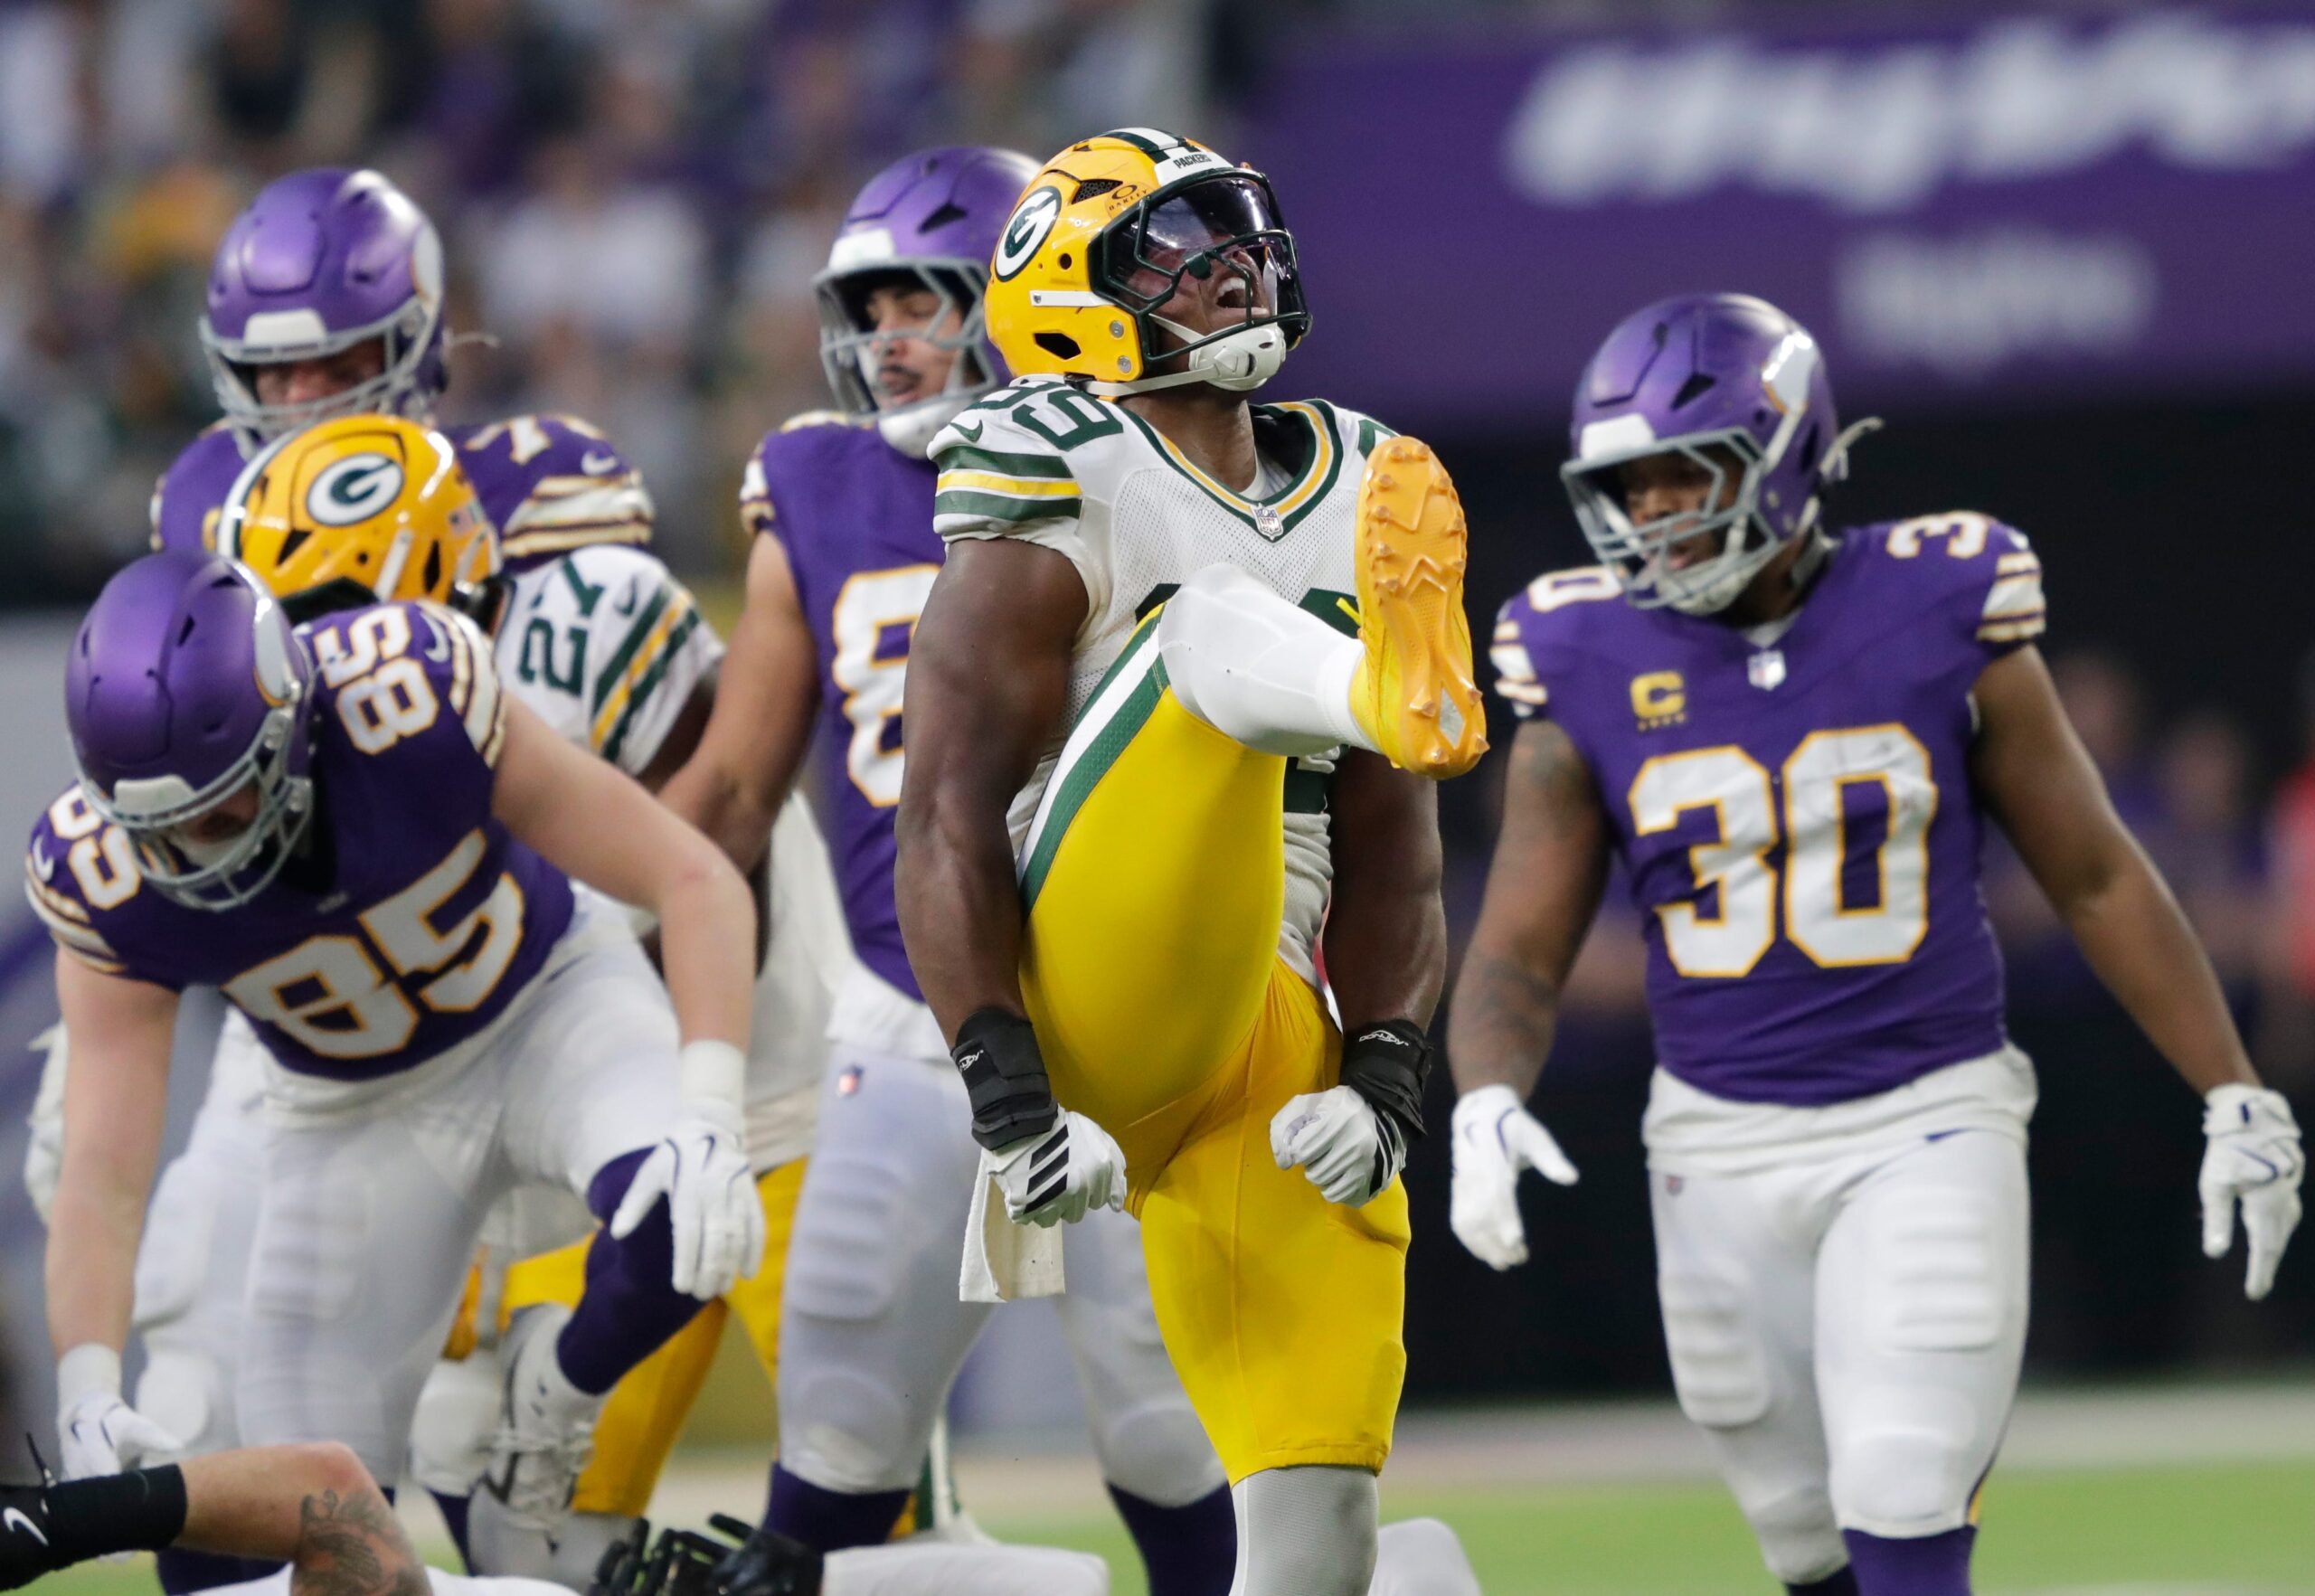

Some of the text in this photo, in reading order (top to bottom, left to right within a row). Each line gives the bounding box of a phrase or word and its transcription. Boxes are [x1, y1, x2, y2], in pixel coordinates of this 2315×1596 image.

[1173, 154, 1212, 169] PACKERS
[995, 186, 1062, 282] G
[307, 451, 404, 526] G
[313, 603, 440, 756] 85
[1630, 670, 1685, 718] C
[1628, 722, 1937, 977] 30
[220, 826, 524, 1060] 85
